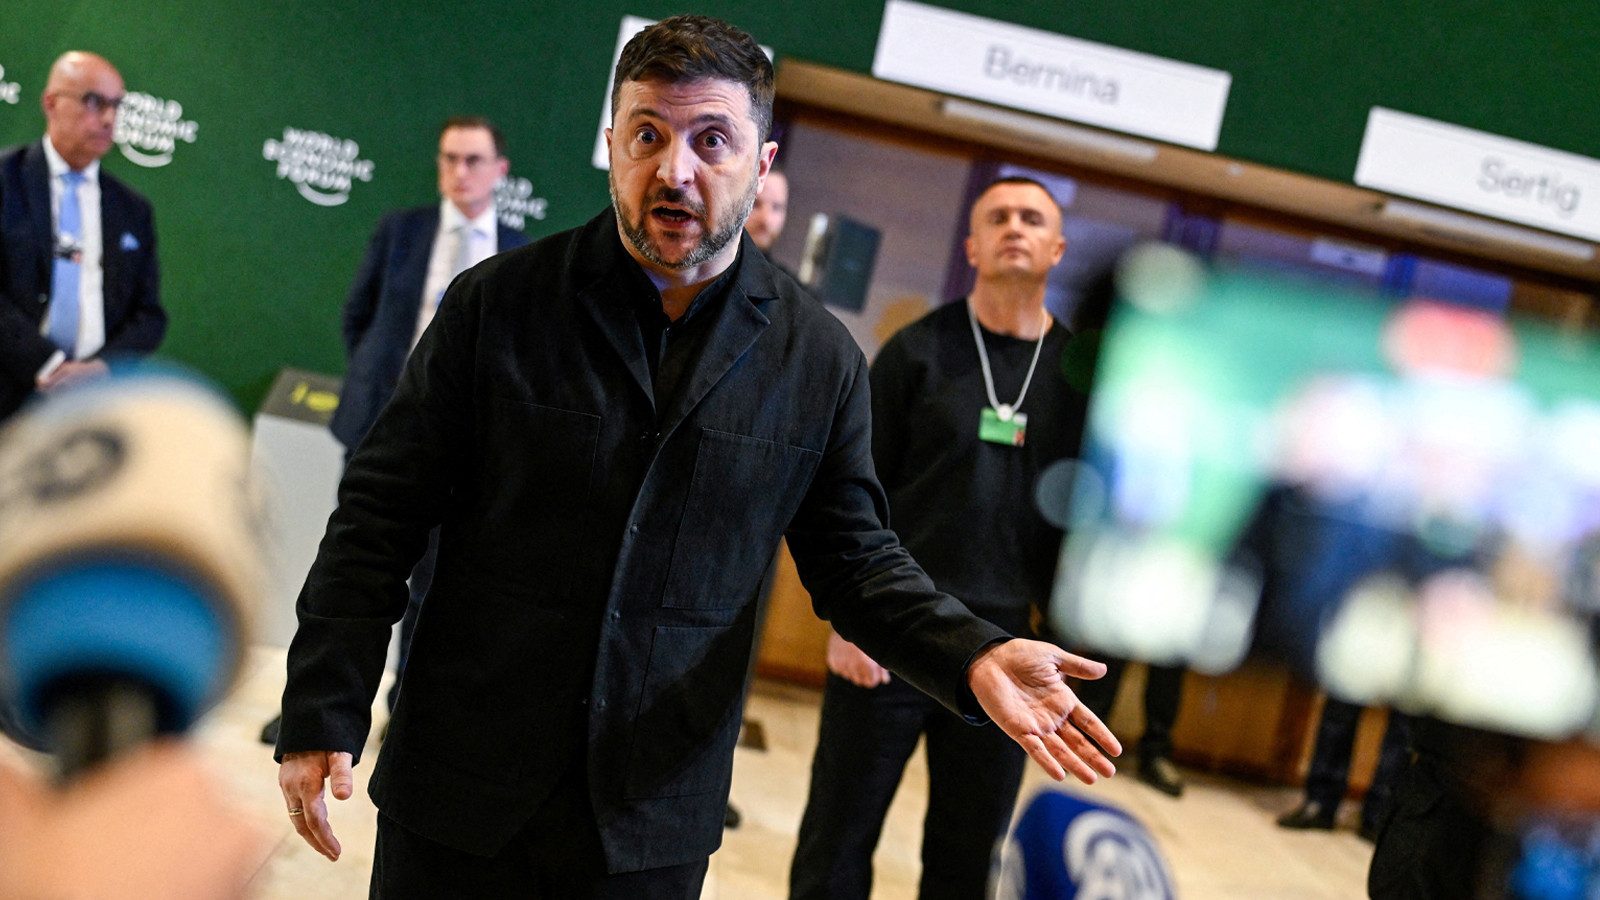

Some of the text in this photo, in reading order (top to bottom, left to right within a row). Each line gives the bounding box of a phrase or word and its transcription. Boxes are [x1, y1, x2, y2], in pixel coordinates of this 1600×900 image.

[984, 45, 1119, 103] Bernina
[123, 91, 182, 122] ORLD
[112, 124, 175, 153] ORUM
[283, 126, 359, 161] WORLD
[263, 138, 375, 182] ECONOMIC
[276, 159, 351, 193] FORUM
[1477, 155, 1580, 220] Sertig
